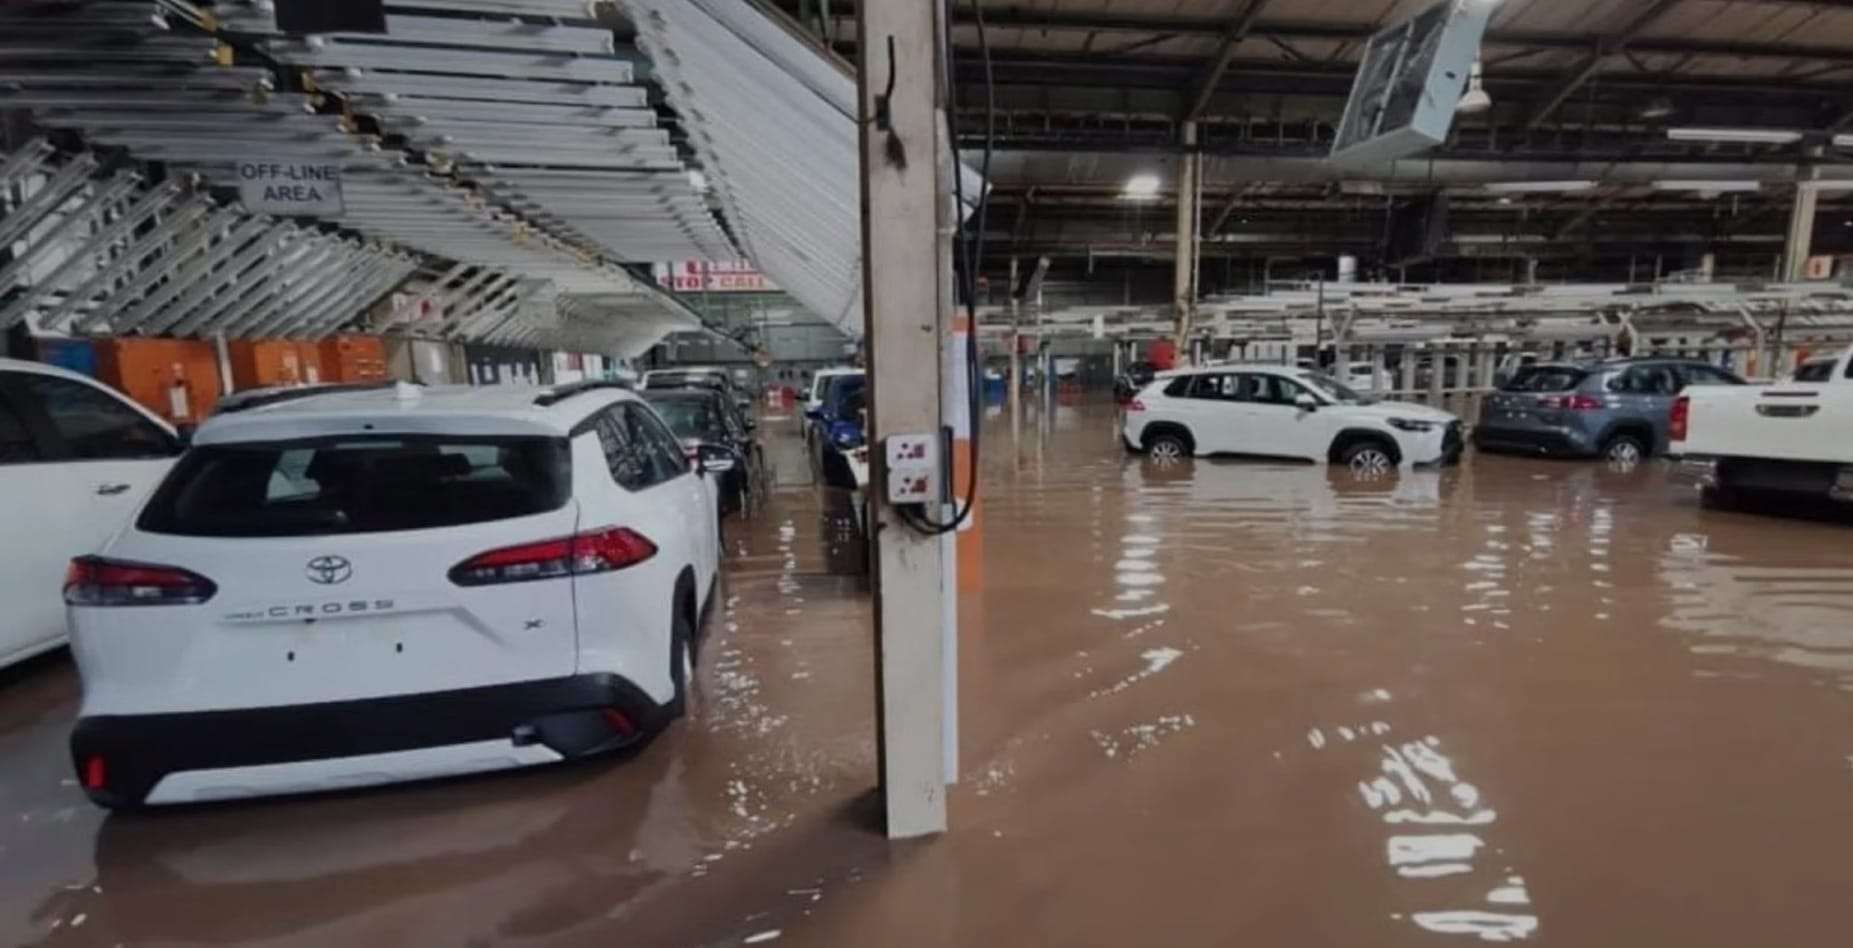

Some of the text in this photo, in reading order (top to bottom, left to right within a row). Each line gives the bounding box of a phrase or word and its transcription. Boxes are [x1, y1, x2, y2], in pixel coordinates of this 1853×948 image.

[241, 164, 338, 180] OFF-LINE
[263, 186, 322, 201] AREA
[268, 600, 394, 617] CROSS
